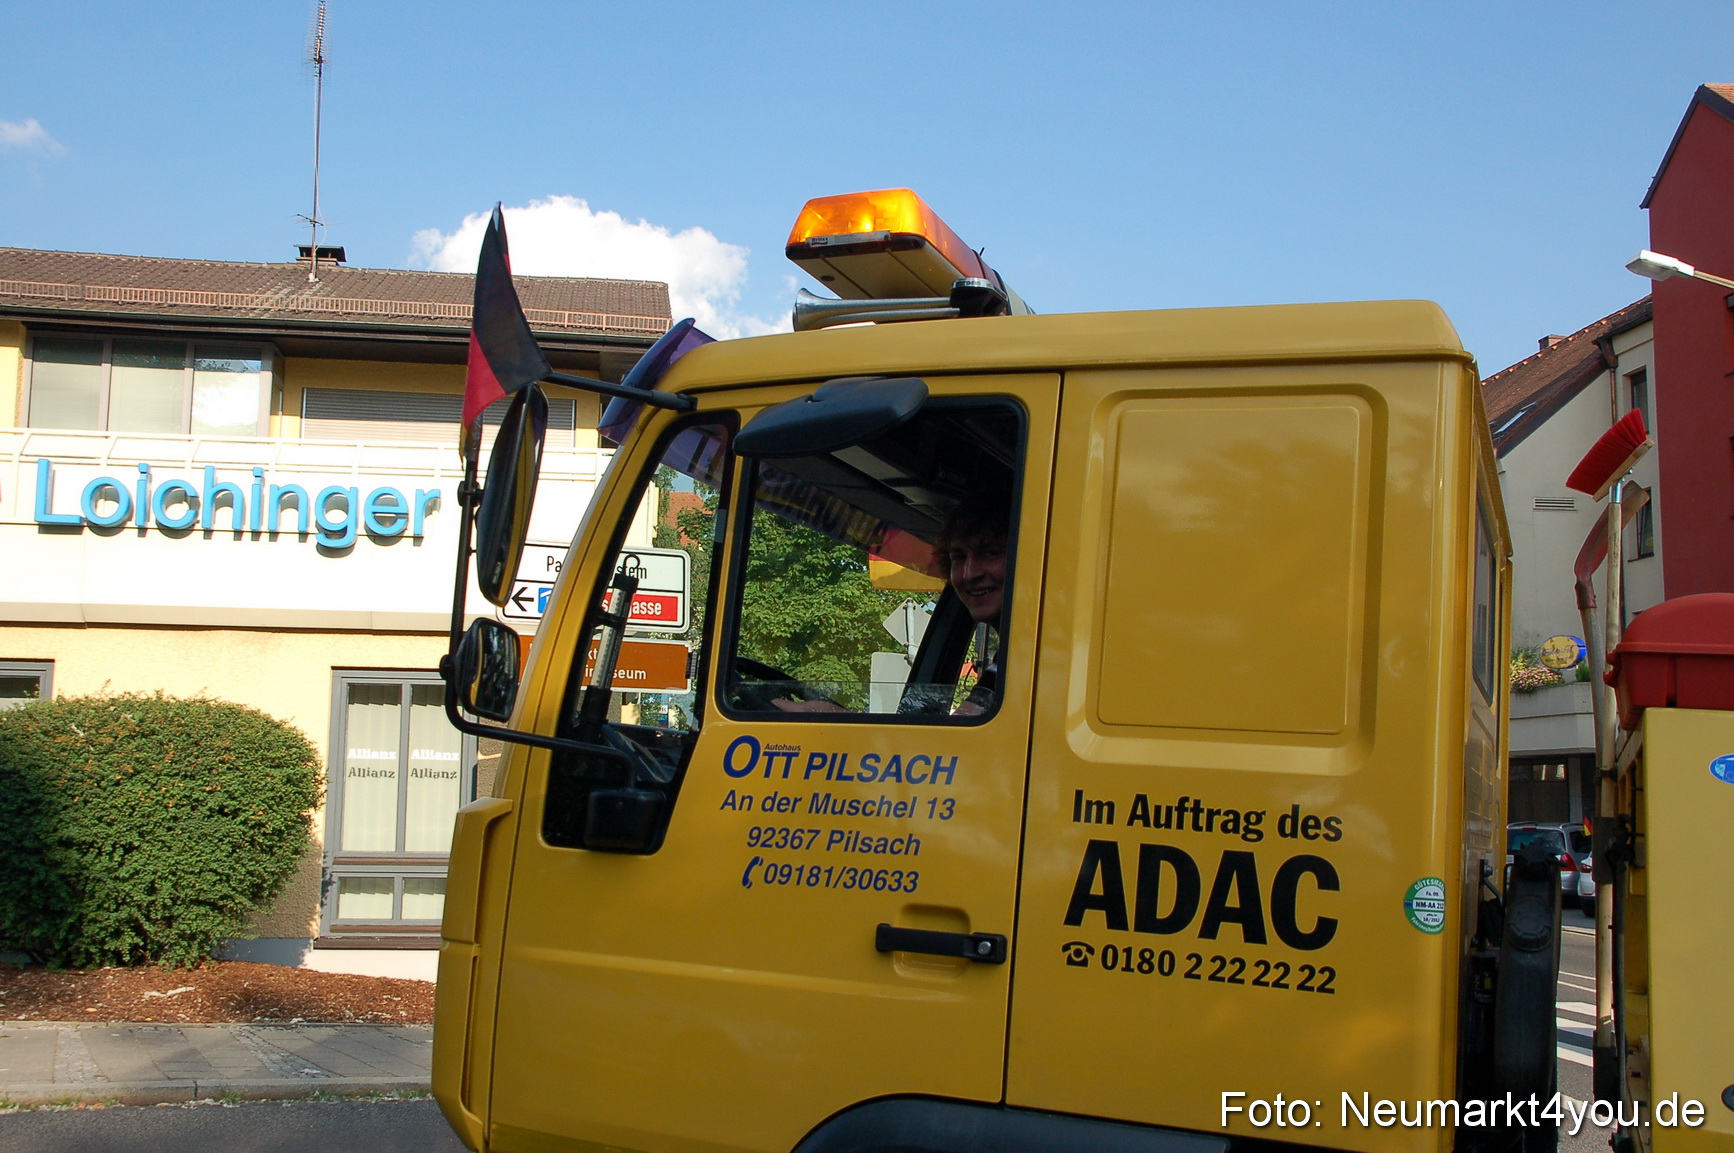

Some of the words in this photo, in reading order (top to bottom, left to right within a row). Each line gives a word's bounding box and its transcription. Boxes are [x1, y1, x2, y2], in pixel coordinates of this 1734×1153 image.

[33, 458, 441, 549] Loichinger
[347, 748, 397, 760] Allianz
[410, 749, 460, 761] Allianz
[764, 743, 802, 752] Autohaus
[803, 752, 959, 786] PILSACH
[720, 789, 754, 812] An
[761, 791, 802, 814] der
[807, 792, 918, 819] Muschel
[927, 797, 956, 820] 13
[1072, 789, 1115, 825] Im
[1126, 793, 1267, 843] Auftrag
[1277, 804, 1344, 843] des
[746, 826, 822, 851] 92367
[826, 829, 922, 856] Pilsach
[763, 862, 920, 894] 09181/30633
[1063, 839, 1341, 951] ADAC
[1100, 943, 1176, 977] 0180
